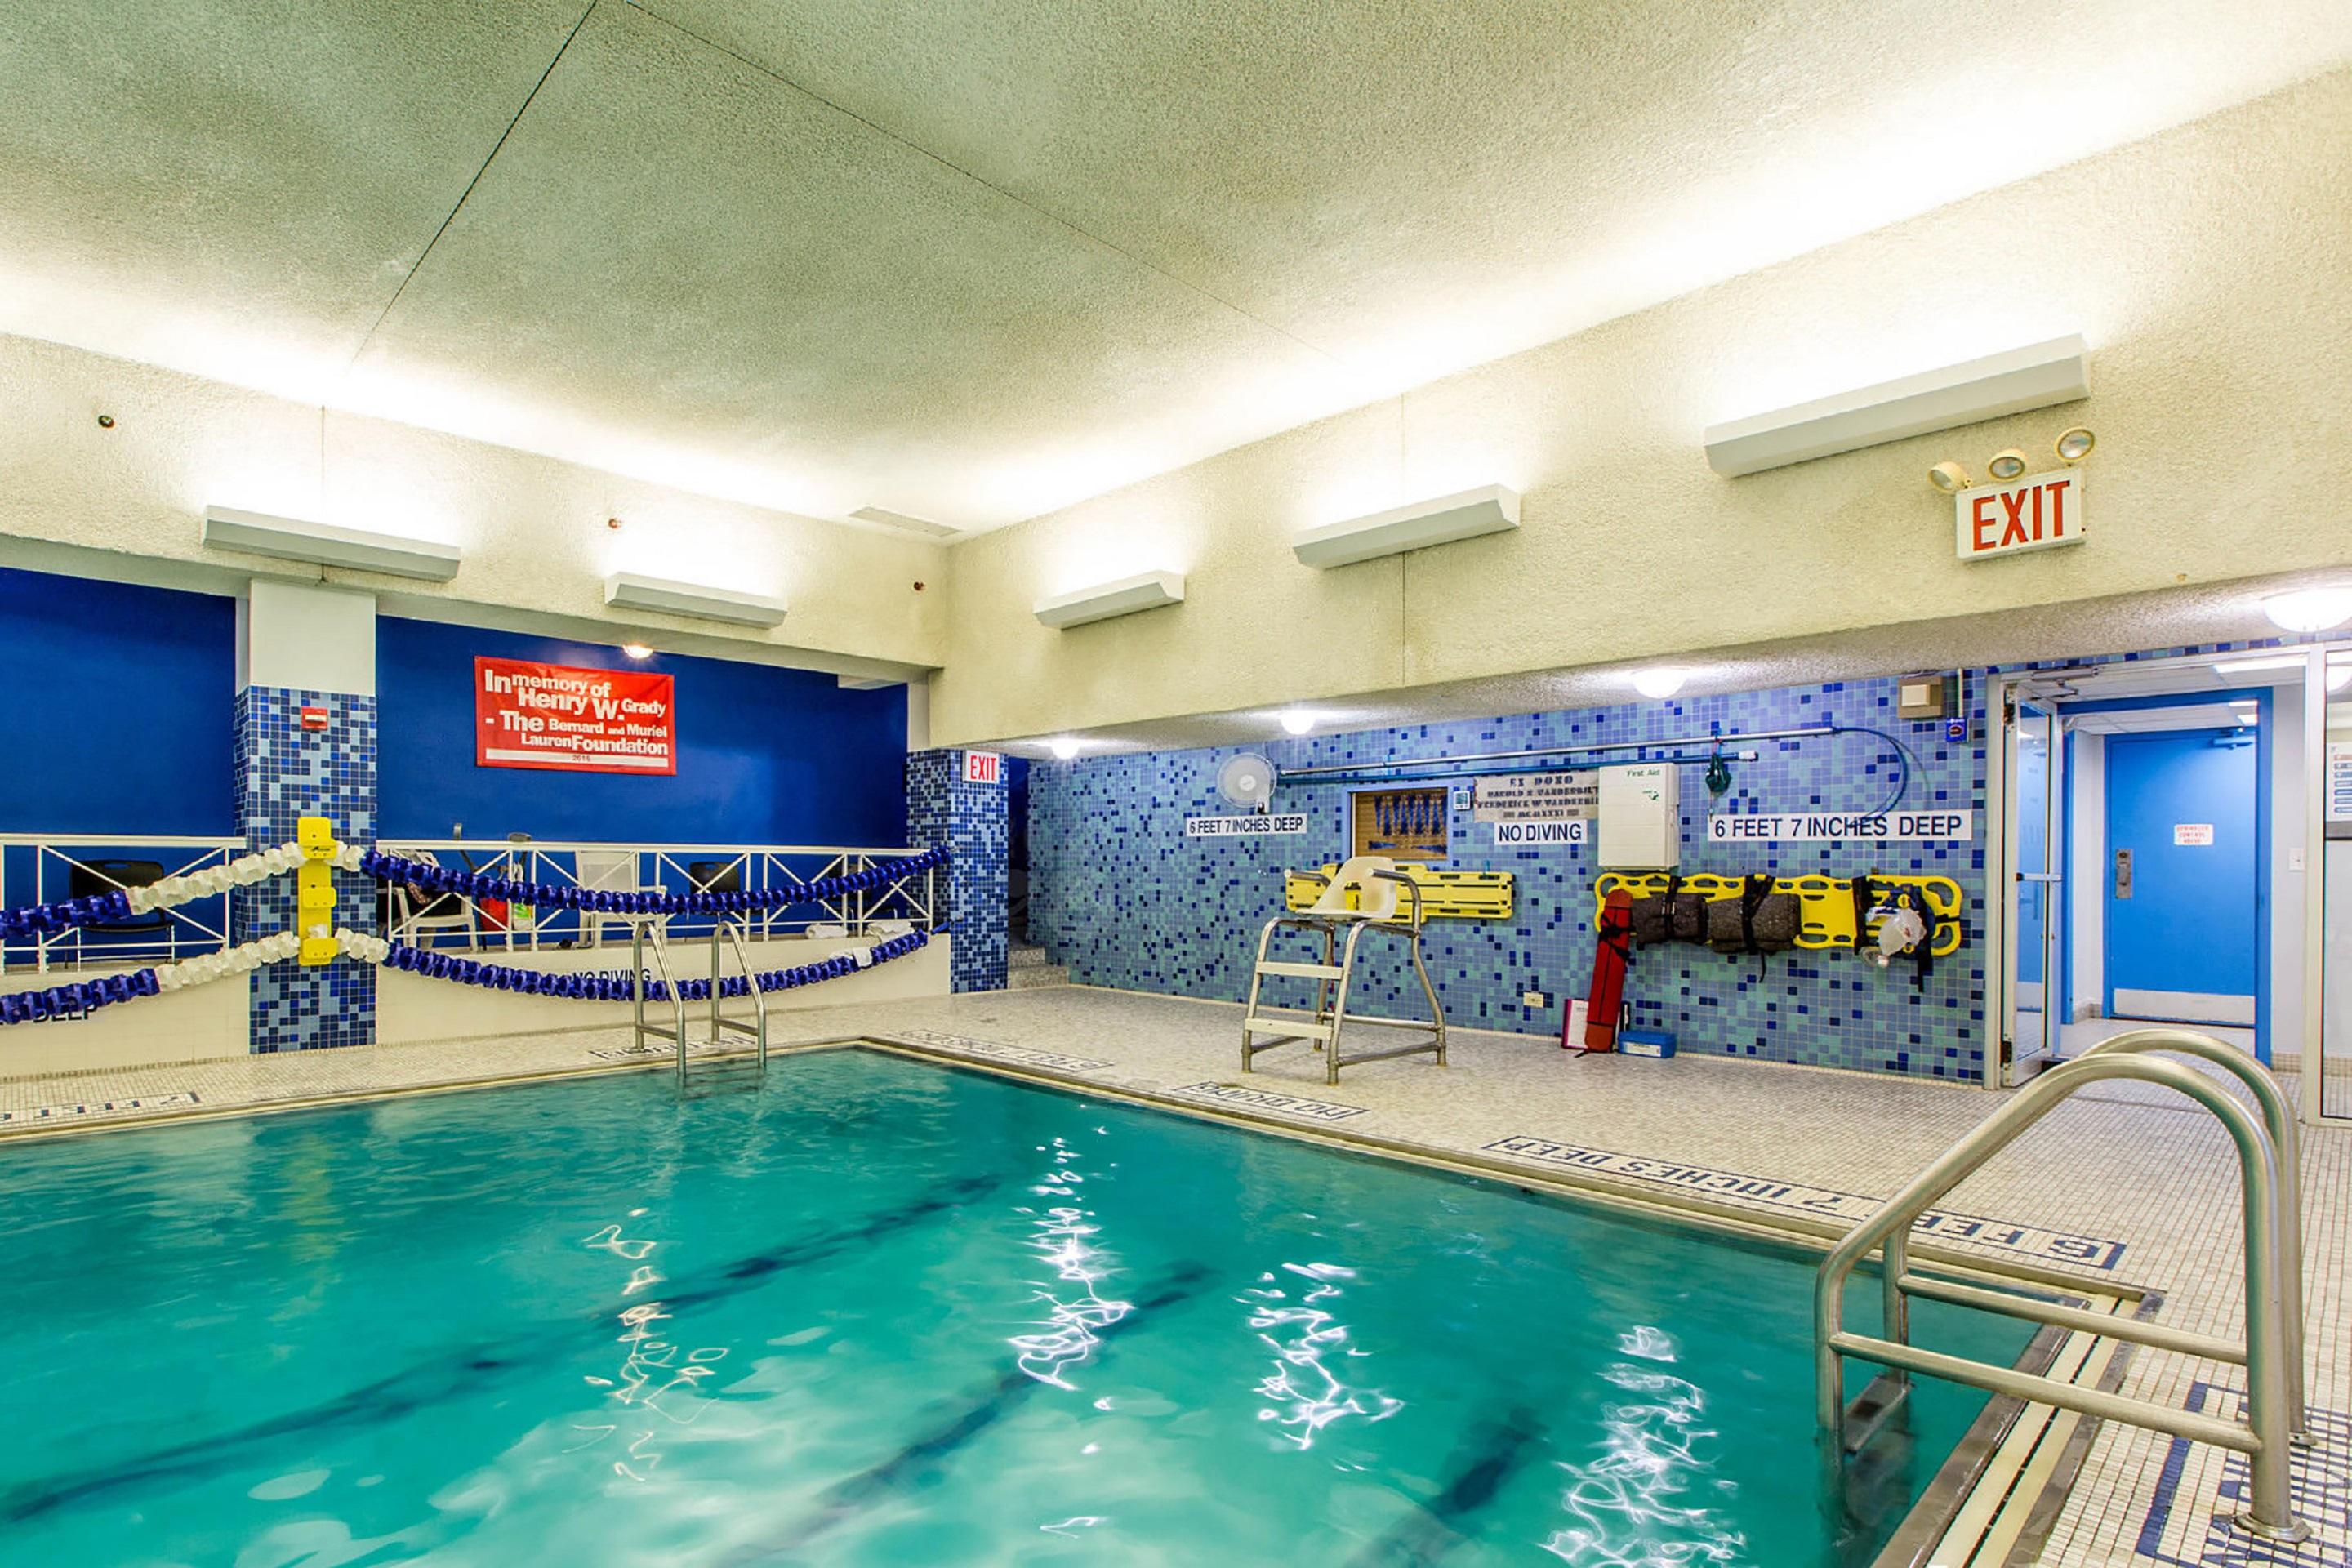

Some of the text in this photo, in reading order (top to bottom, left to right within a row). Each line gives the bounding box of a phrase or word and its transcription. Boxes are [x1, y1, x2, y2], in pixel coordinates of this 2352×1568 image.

[1972, 479, 2070, 552] EXIT
[485, 669, 612, 698] In memory of
[518, 688, 666, 721] Henry W. Grady
[499, 709, 543, 733] The
[548, 718, 604, 735] Bernard
[607, 726, 626, 736] and
[626, 724, 667, 738] Muriel
[521, 732, 669, 755] Lauren Foundation
[969, 755, 997, 782] EXIT
[1189, 817, 1303, 834] 6 FEET 7 INCHES DEEP
[1499, 822, 1581, 842] NO DIVING
[1714, 815, 1962, 838] 6 FEET 7 INCHES DEEP
[1503, 1142, 1614, 1166] DEEP
[1619, 1160, 1792, 1200] INCHES
[1801, 1195, 1843, 1210] 7
[2050, 1238, 2098, 1260] 6
